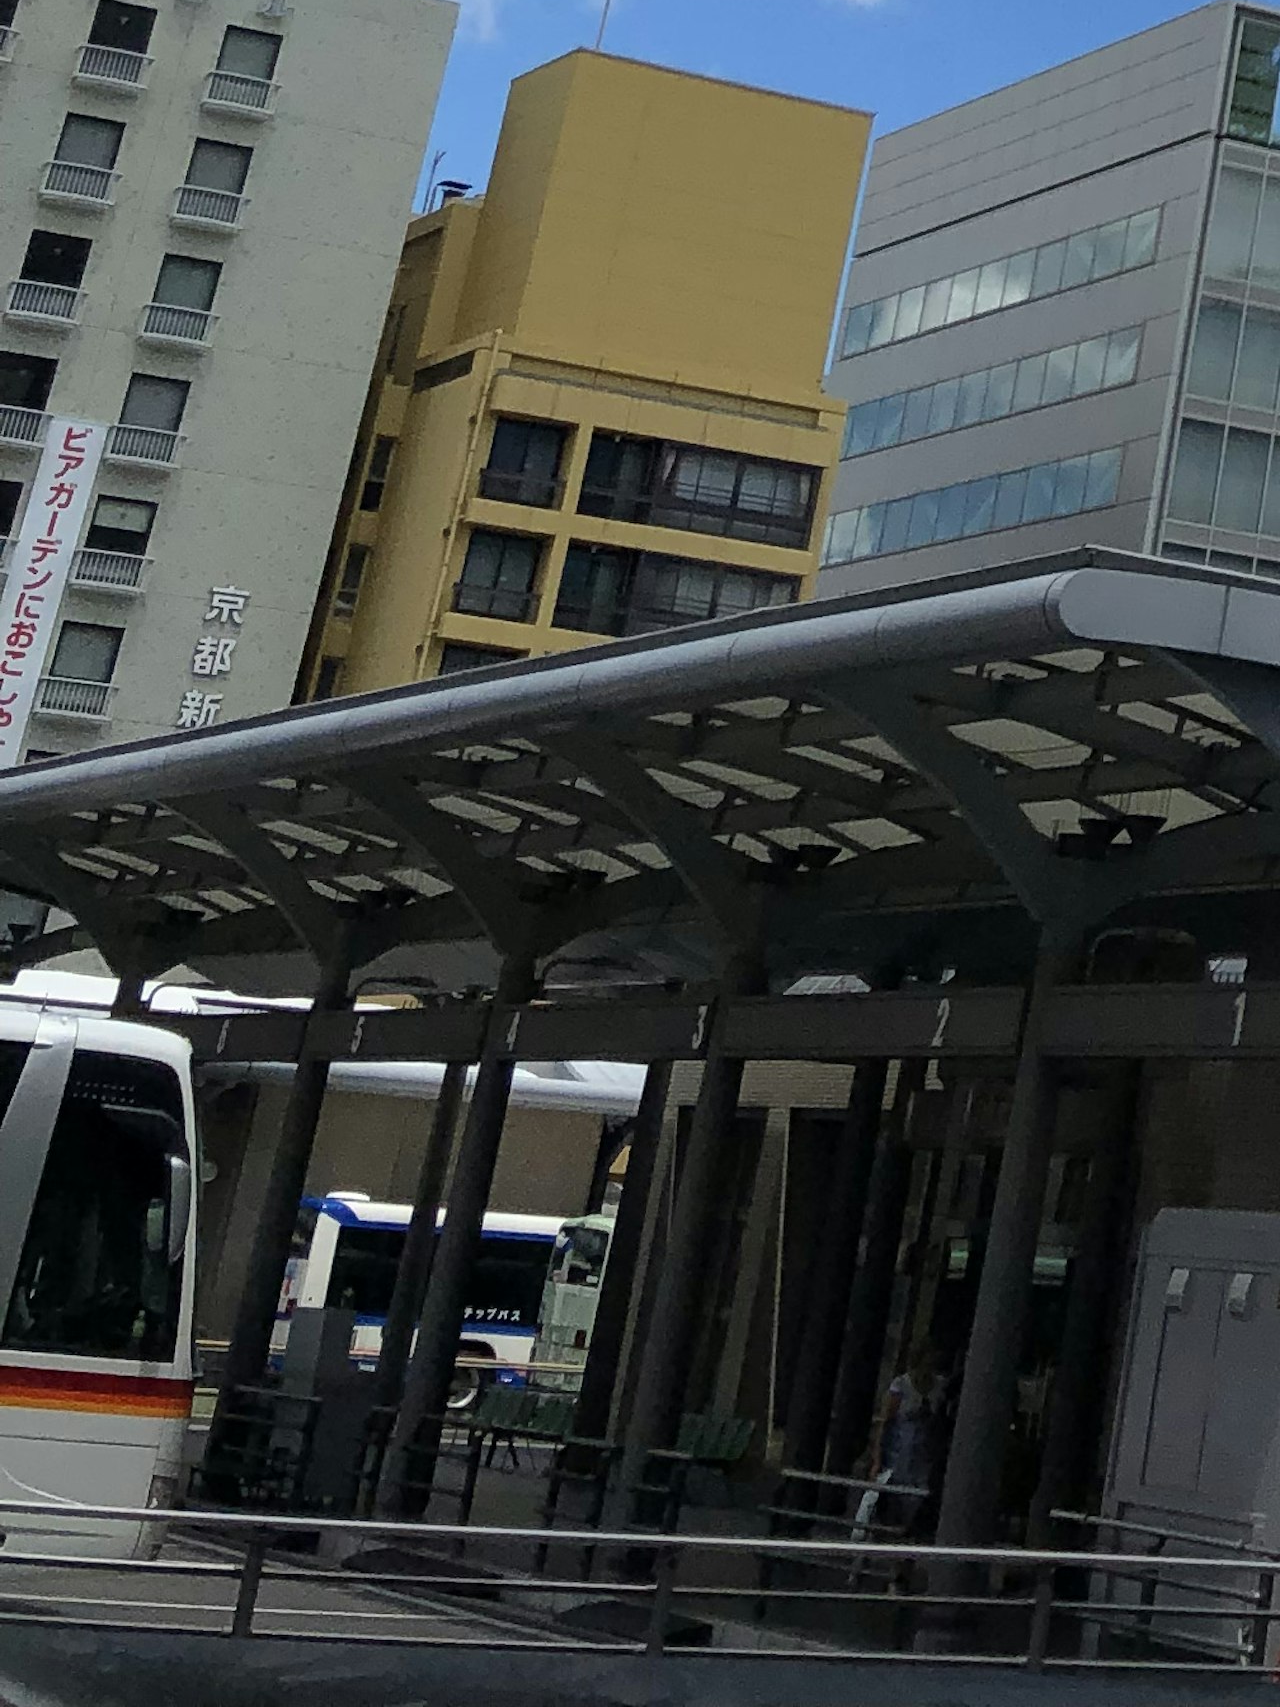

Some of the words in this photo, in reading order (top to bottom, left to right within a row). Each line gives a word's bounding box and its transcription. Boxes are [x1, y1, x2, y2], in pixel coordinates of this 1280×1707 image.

[351, 1015, 366, 1054] 5
[506, 1011, 521, 1052] 4
[691, 1005, 709, 1050] 3
[931, 997, 949, 1047] 2
[1230, 991, 1247, 1047] 1
